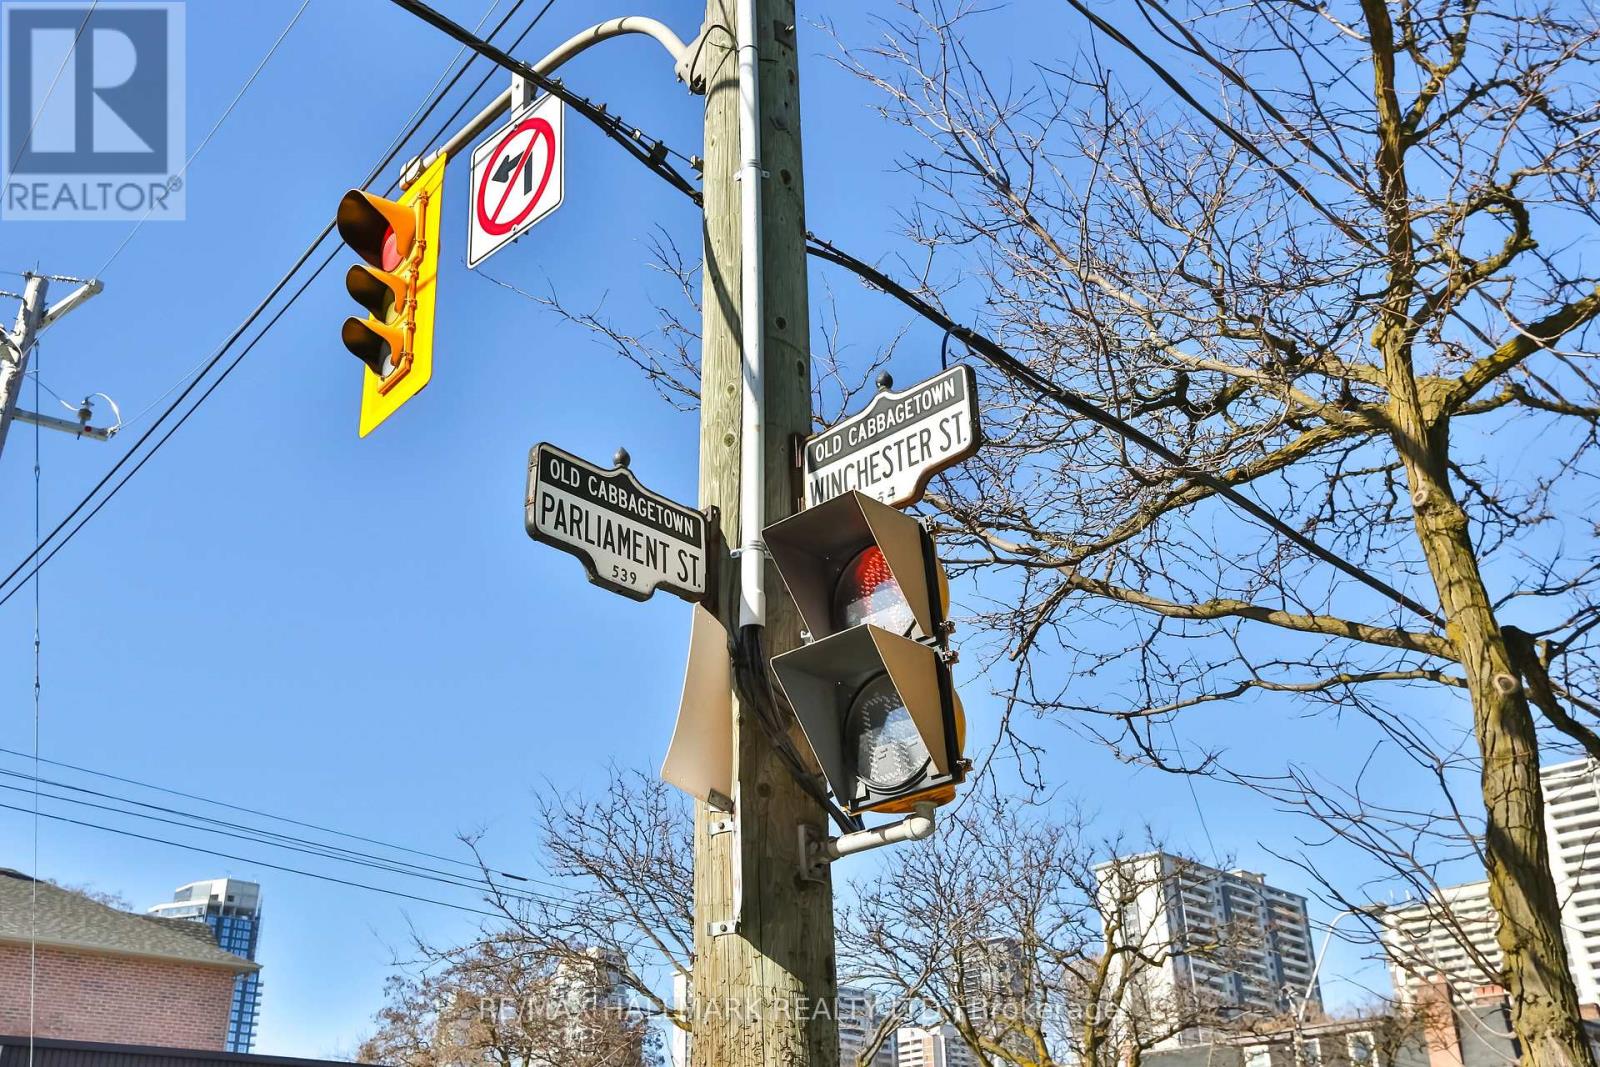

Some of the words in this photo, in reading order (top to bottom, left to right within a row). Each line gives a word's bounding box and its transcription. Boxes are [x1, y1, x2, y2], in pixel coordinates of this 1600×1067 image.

[810, 427, 932, 506] WINCHESTER
[939, 411, 967, 453] ST.
[815, 435, 842, 462] OLD
[848, 378, 955, 447] CABBAGETOWN
[541, 491, 670, 574] PARLIAMENT
[677, 549, 702, 588] ST.
[550, 458, 580, 488] OLD
[587, 475, 694, 538] CABBAGETOWN
[611, 565, 637, 585] 539
